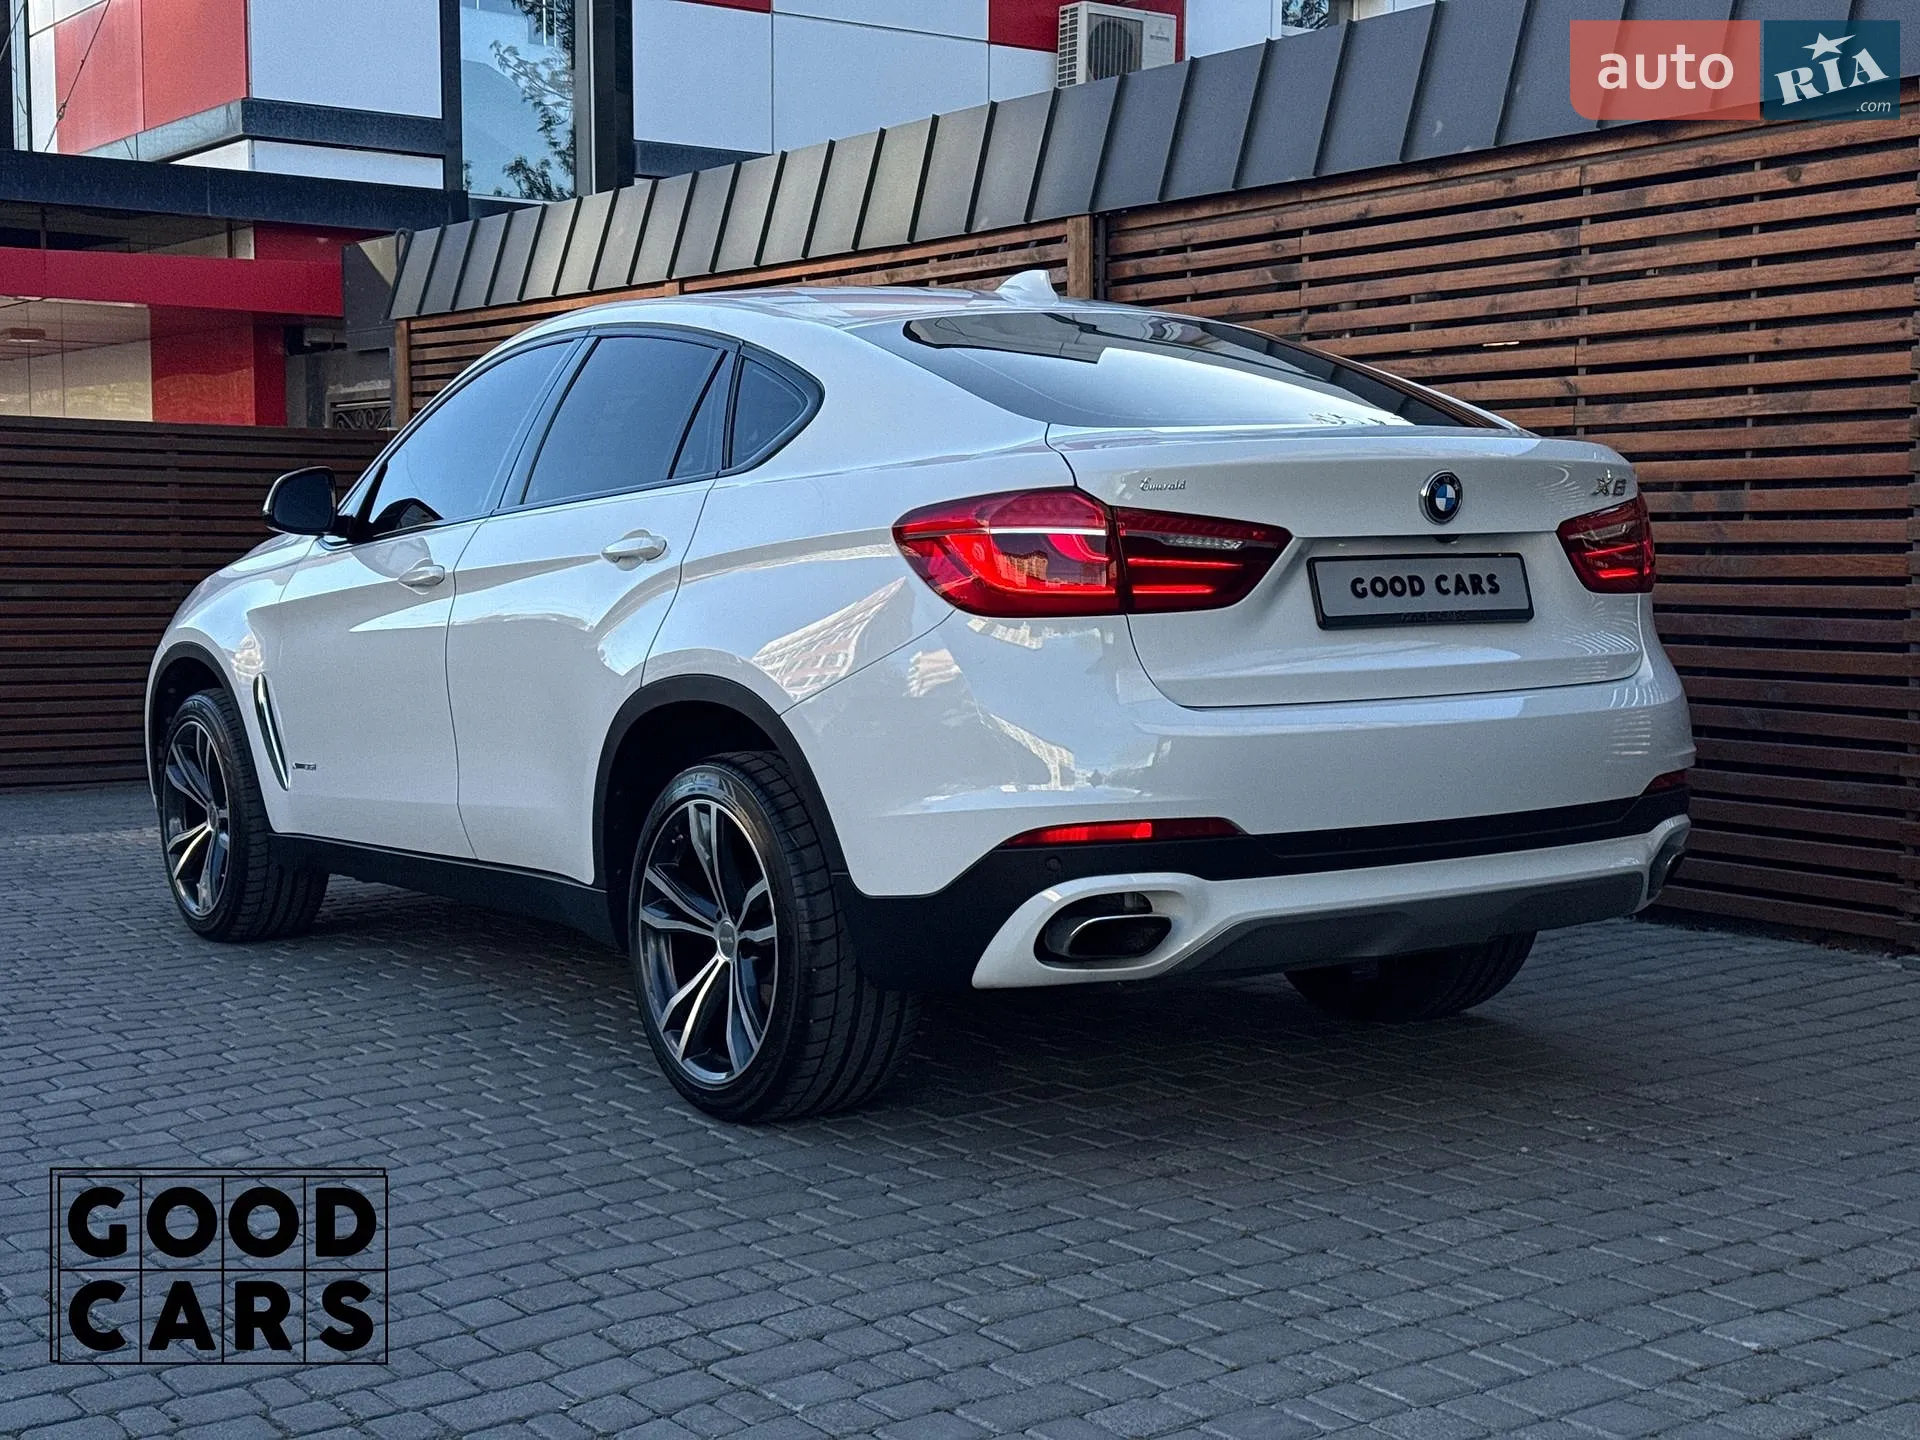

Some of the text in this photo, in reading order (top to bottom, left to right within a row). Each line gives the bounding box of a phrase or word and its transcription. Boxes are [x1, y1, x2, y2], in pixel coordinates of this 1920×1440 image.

[1140, 476, 1187, 491] Emerald
[1591, 477, 1627, 497] X6
[1350, 573, 1501, 599] GOOD CARS
